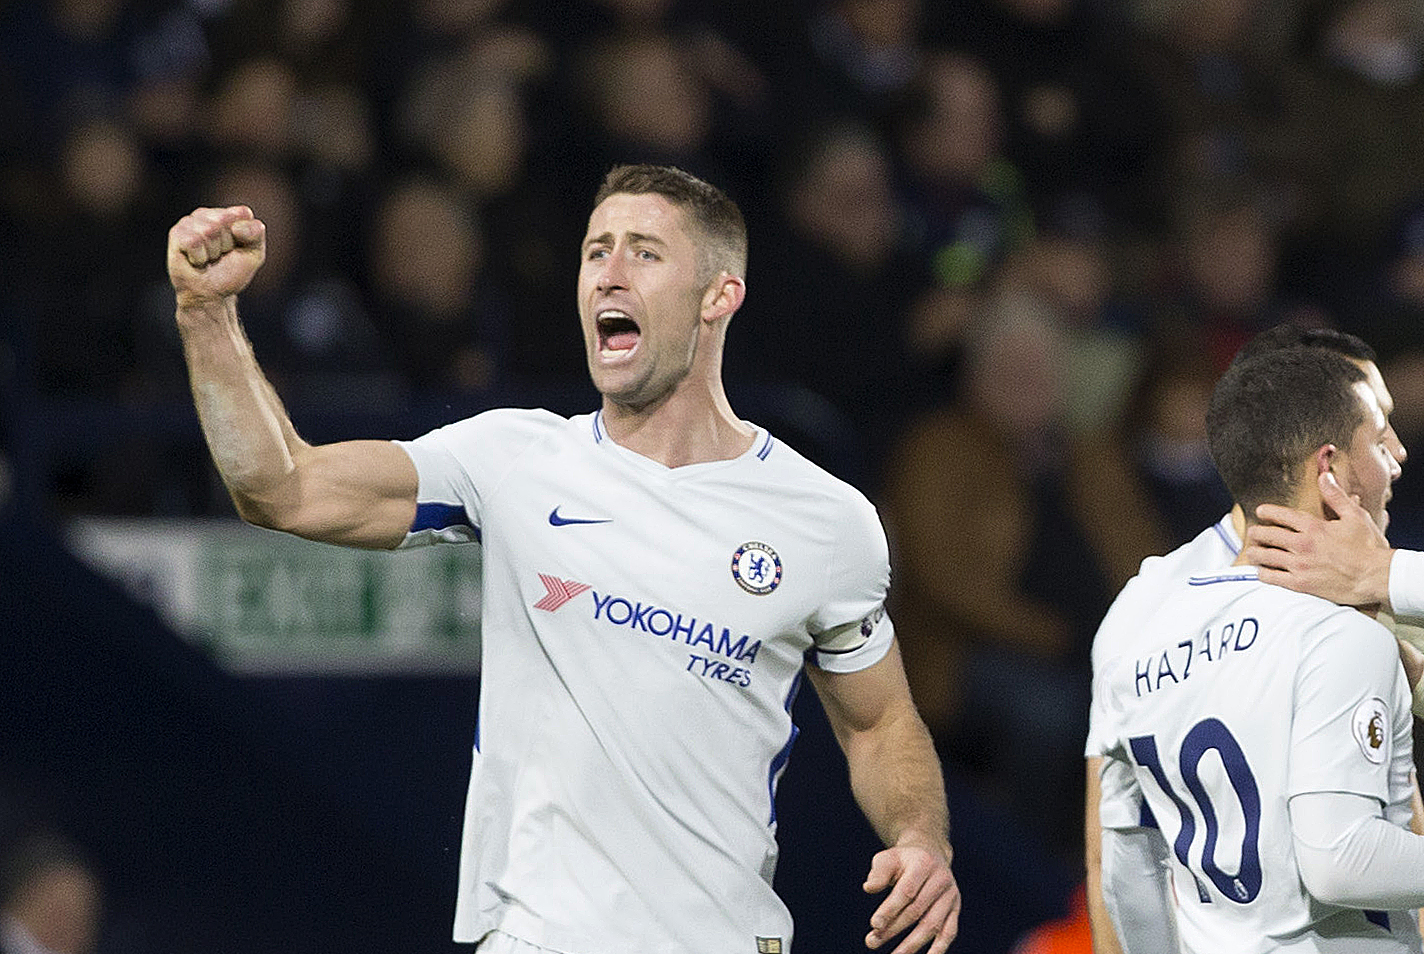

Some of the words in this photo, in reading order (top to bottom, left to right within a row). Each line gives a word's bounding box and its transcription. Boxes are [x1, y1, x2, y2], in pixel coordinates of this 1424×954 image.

[592, 591, 762, 664] YOKOHAMA
[1135, 617, 1259, 697] HAZARD
[686, 653, 752, 688] TYRES
[1128, 717, 1263, 904] 10
